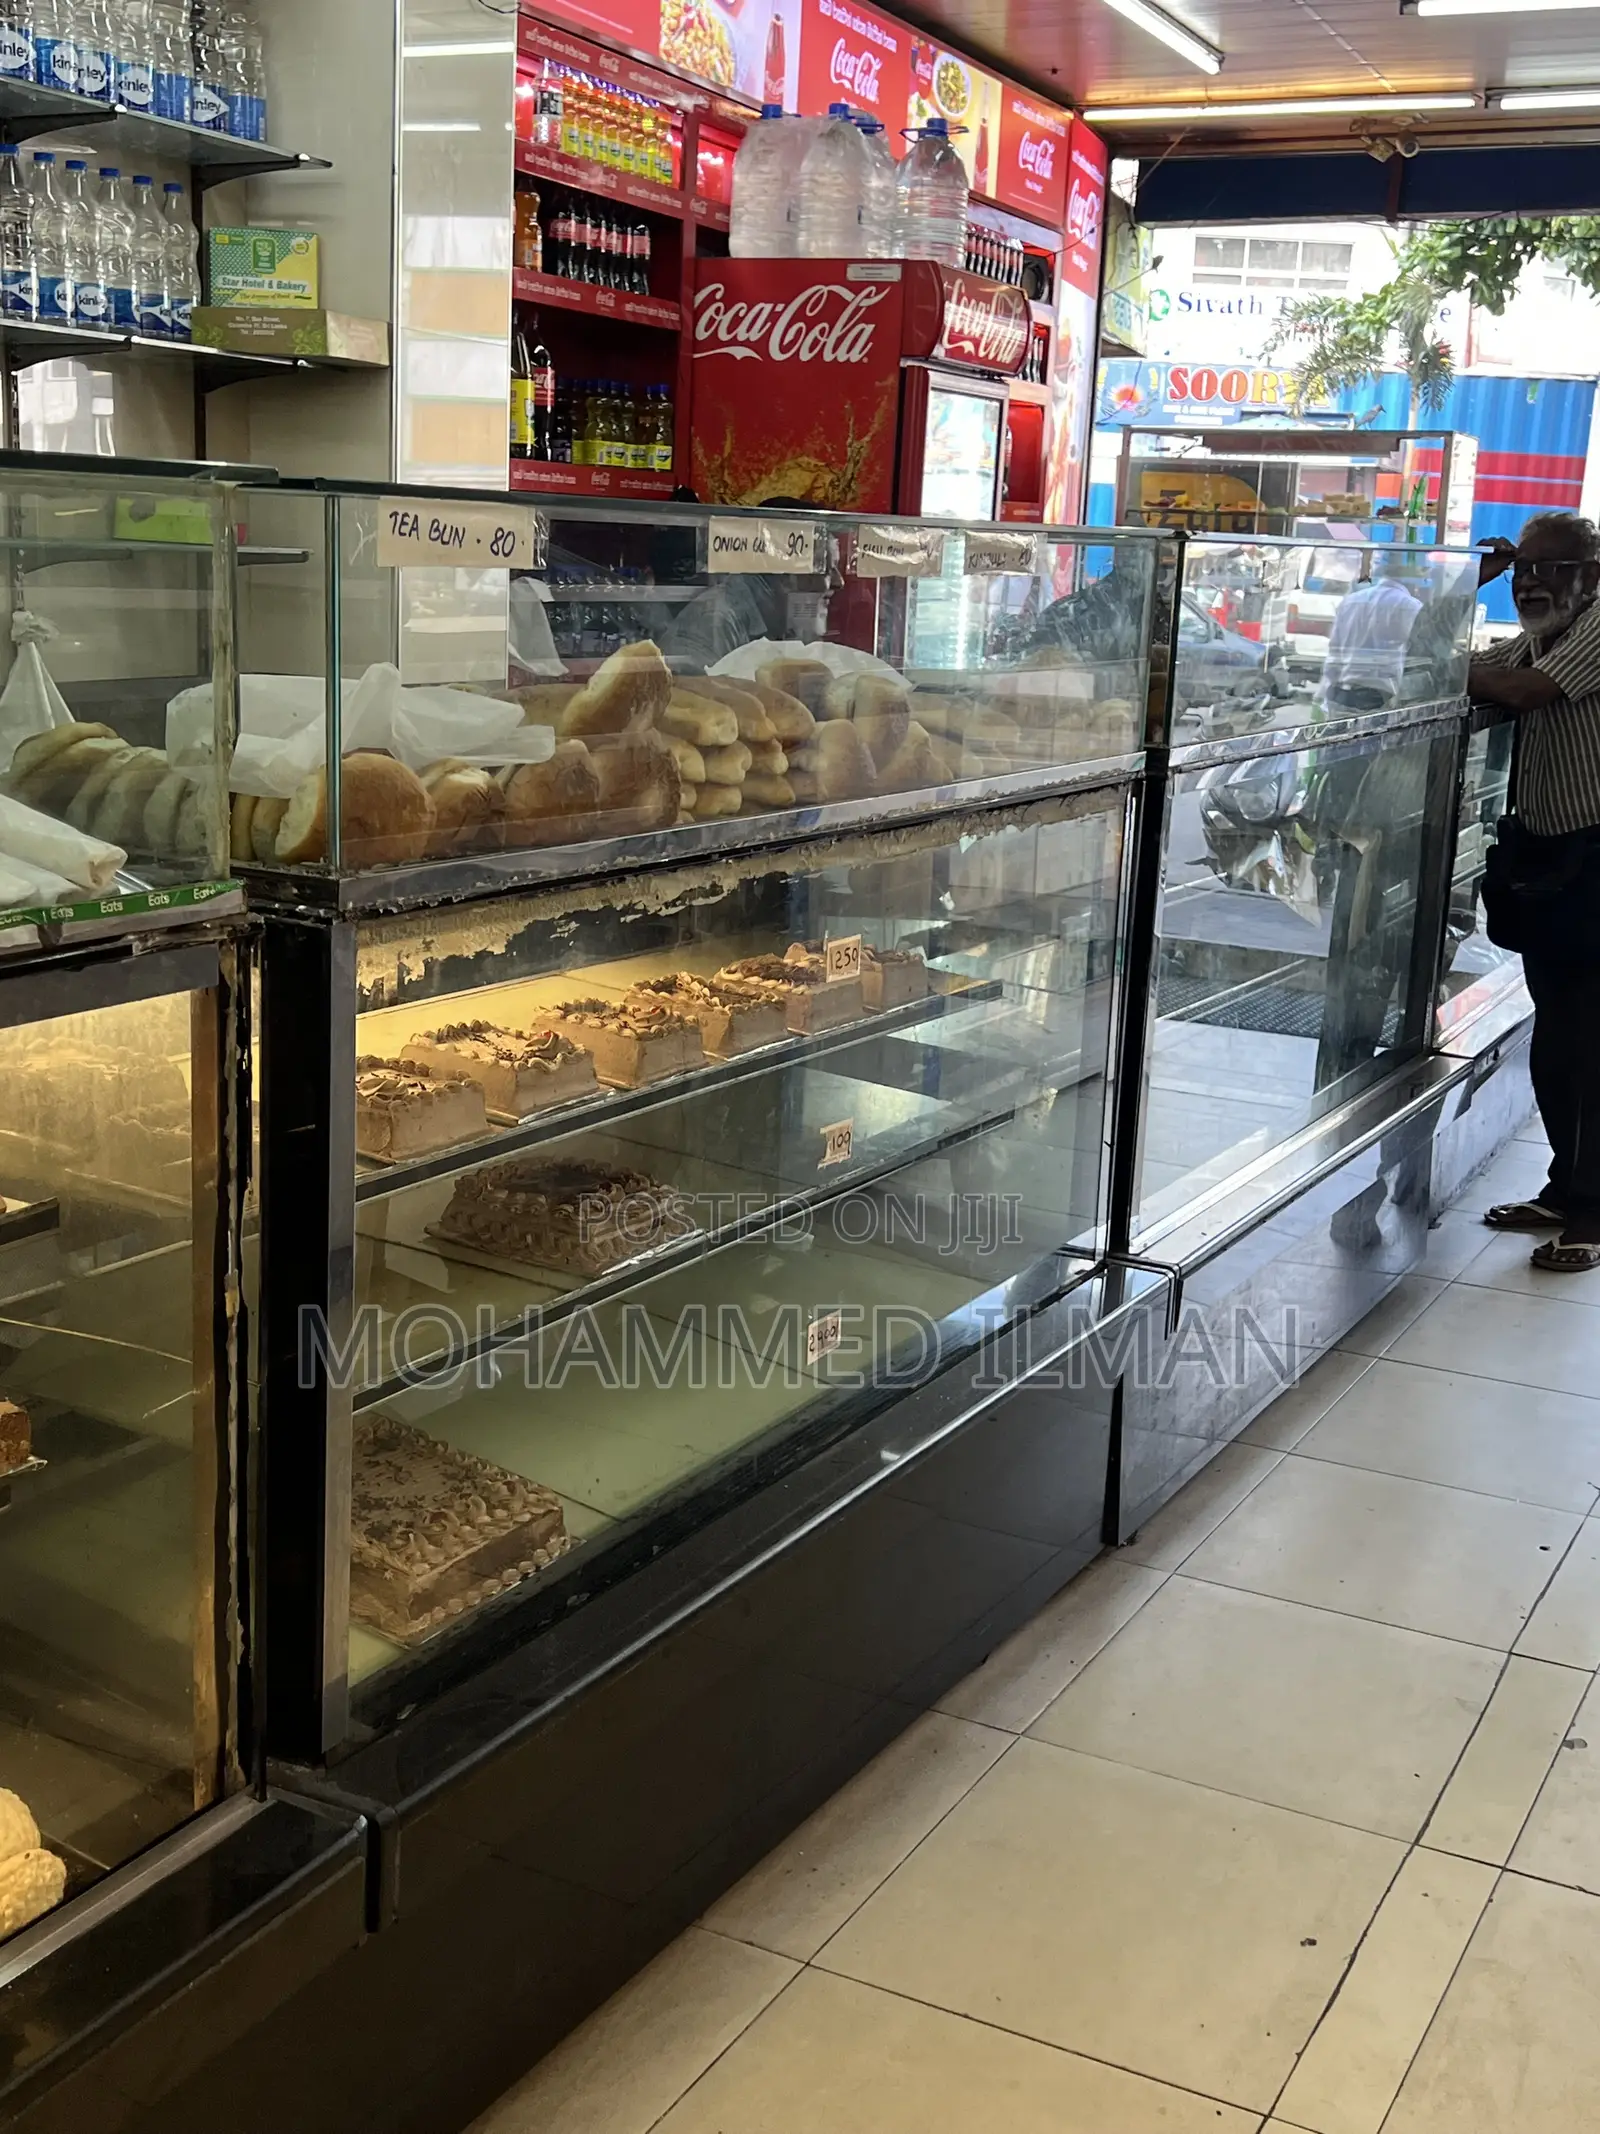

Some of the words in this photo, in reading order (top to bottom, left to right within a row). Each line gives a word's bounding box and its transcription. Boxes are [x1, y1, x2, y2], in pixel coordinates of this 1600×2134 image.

[0, 42, 30, 61] inley
[831, 37, 882, 104] Coca-Cola
[1018, 131, 1055, 180] Coca-Cola
[222, 277, 240, 287] Star
[242, 277, 265, 288] Hotel
[268, 279, 274, 288] &
[276, 280, 308, 292] Bakery
[389, 511, 420, 541] TEA
[428, 518, 466, 549] BUN
[713, 535, 748, 553] ONION
[100, 901, 124, 914] Eats
[148, 894, 171, 906] Eats
